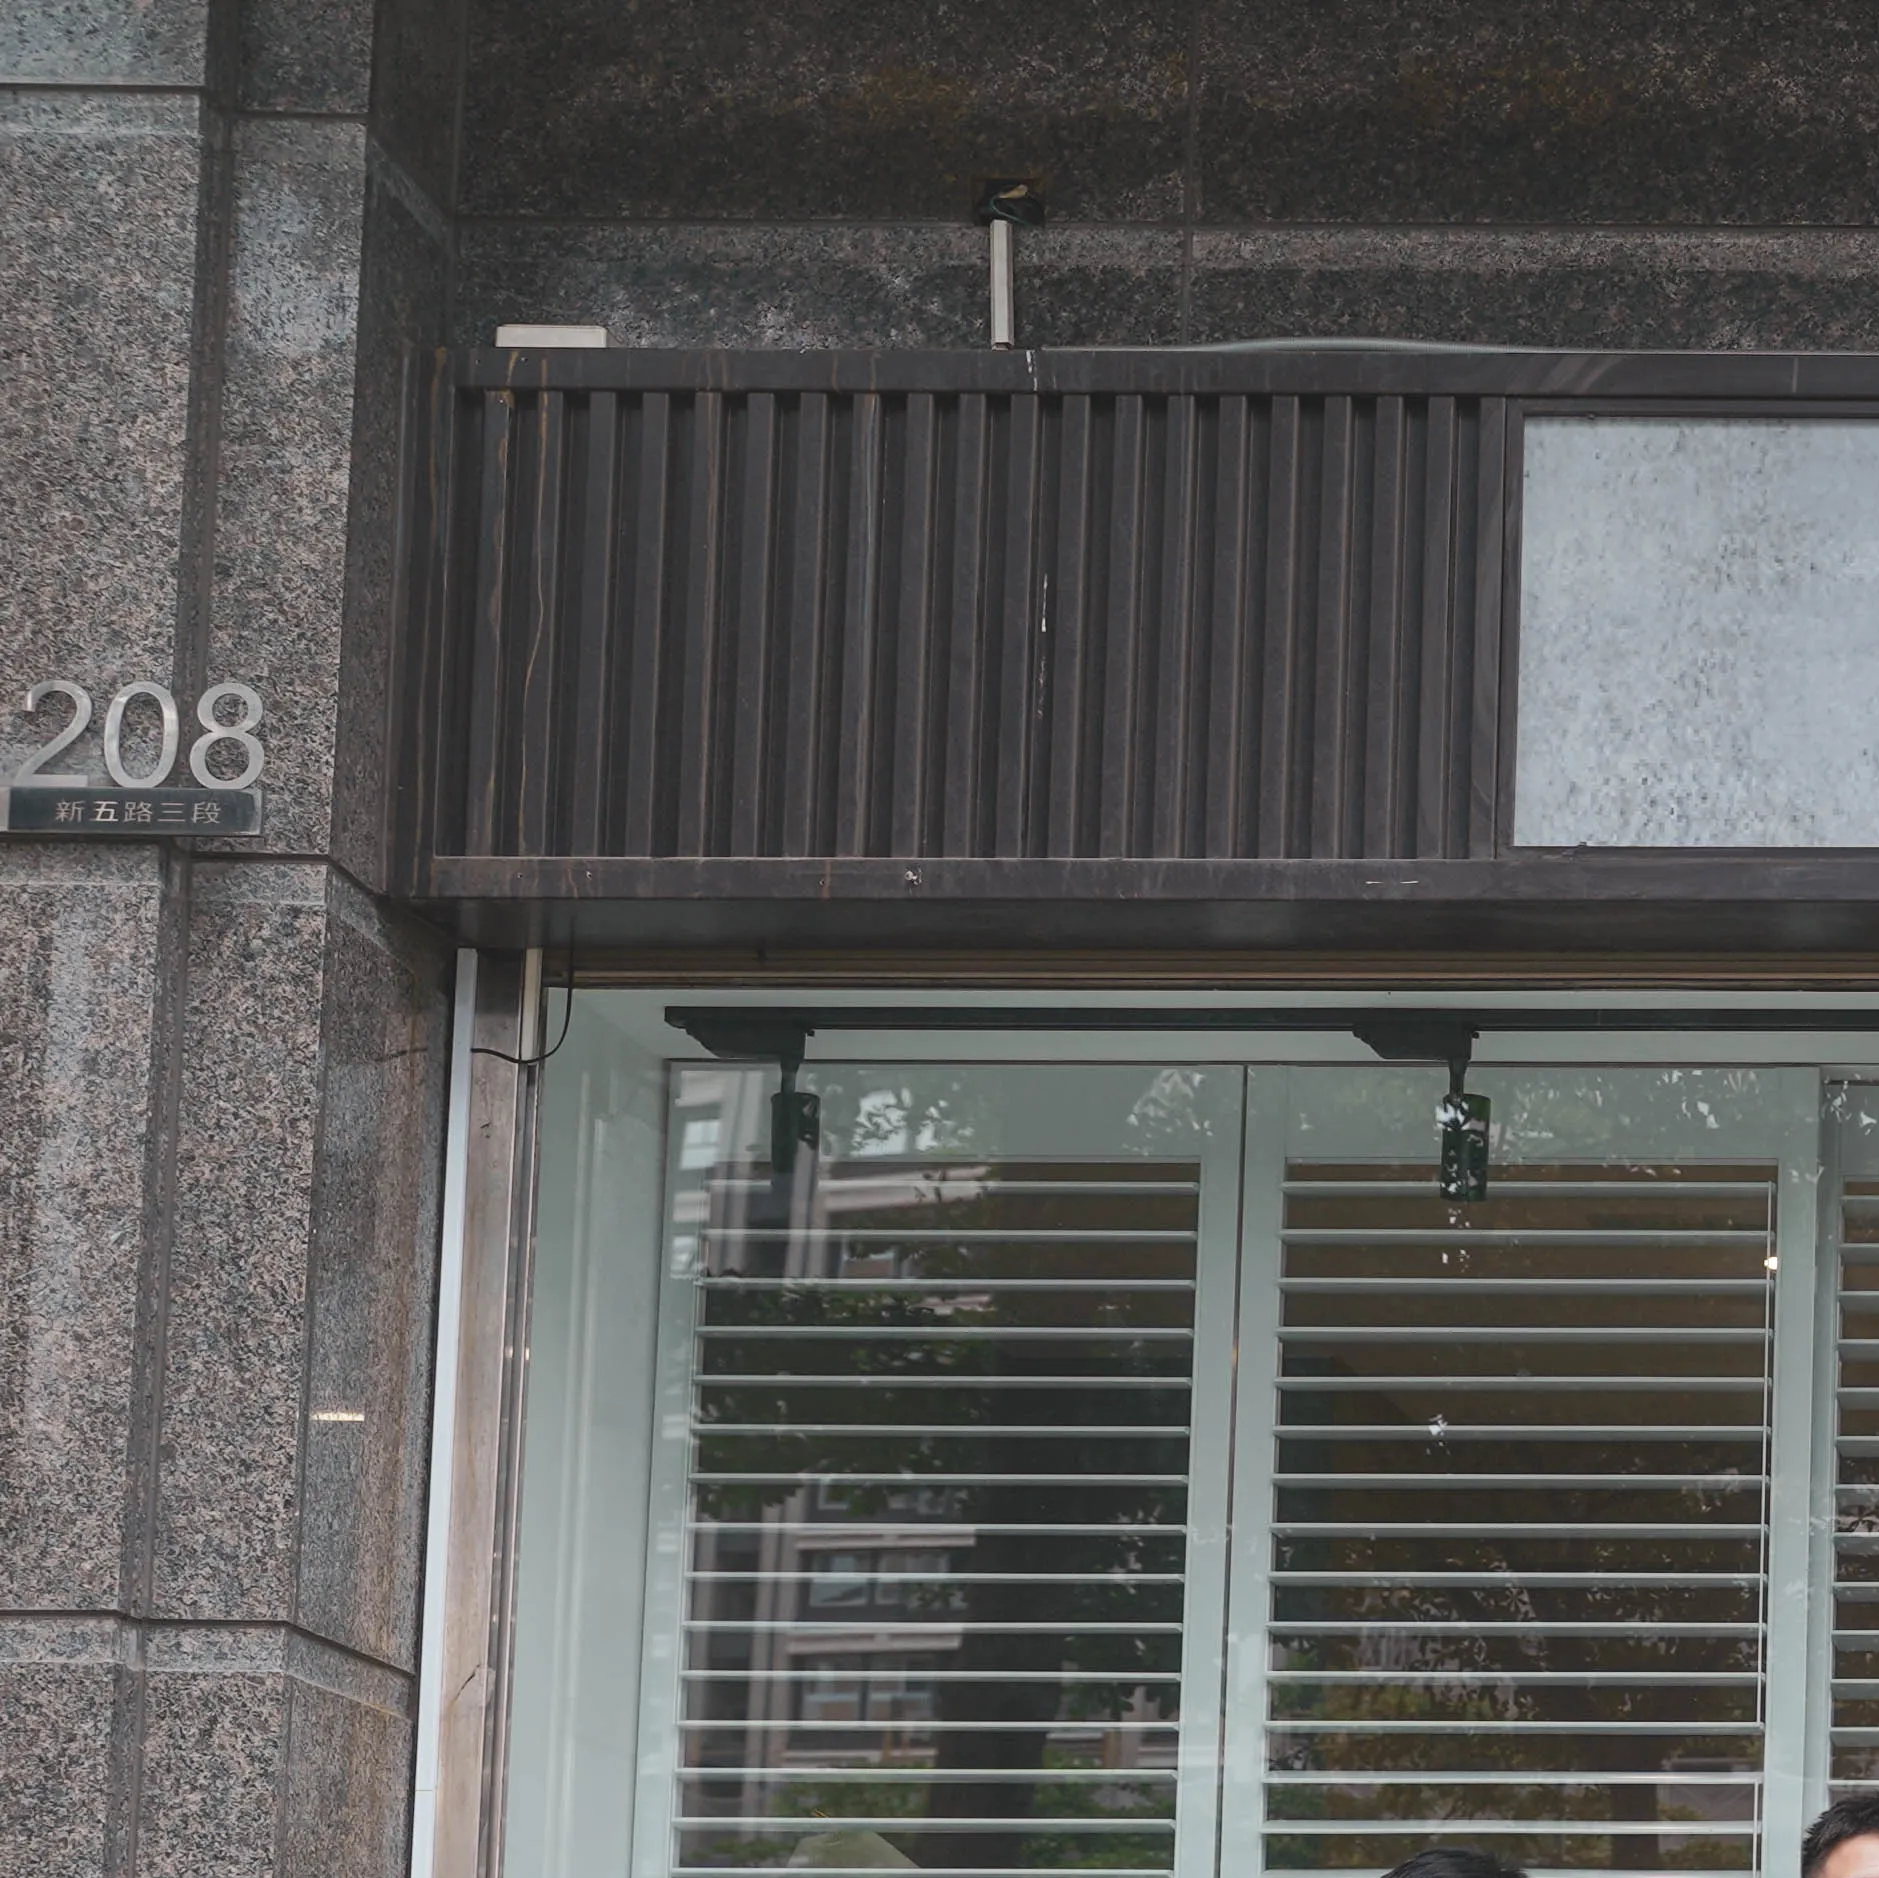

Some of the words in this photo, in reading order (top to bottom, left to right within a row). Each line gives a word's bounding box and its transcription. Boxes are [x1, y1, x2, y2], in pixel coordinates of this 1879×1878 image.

[13, 679, 265, 789] 208
[54, 799, 222, 824] 新五路三段
